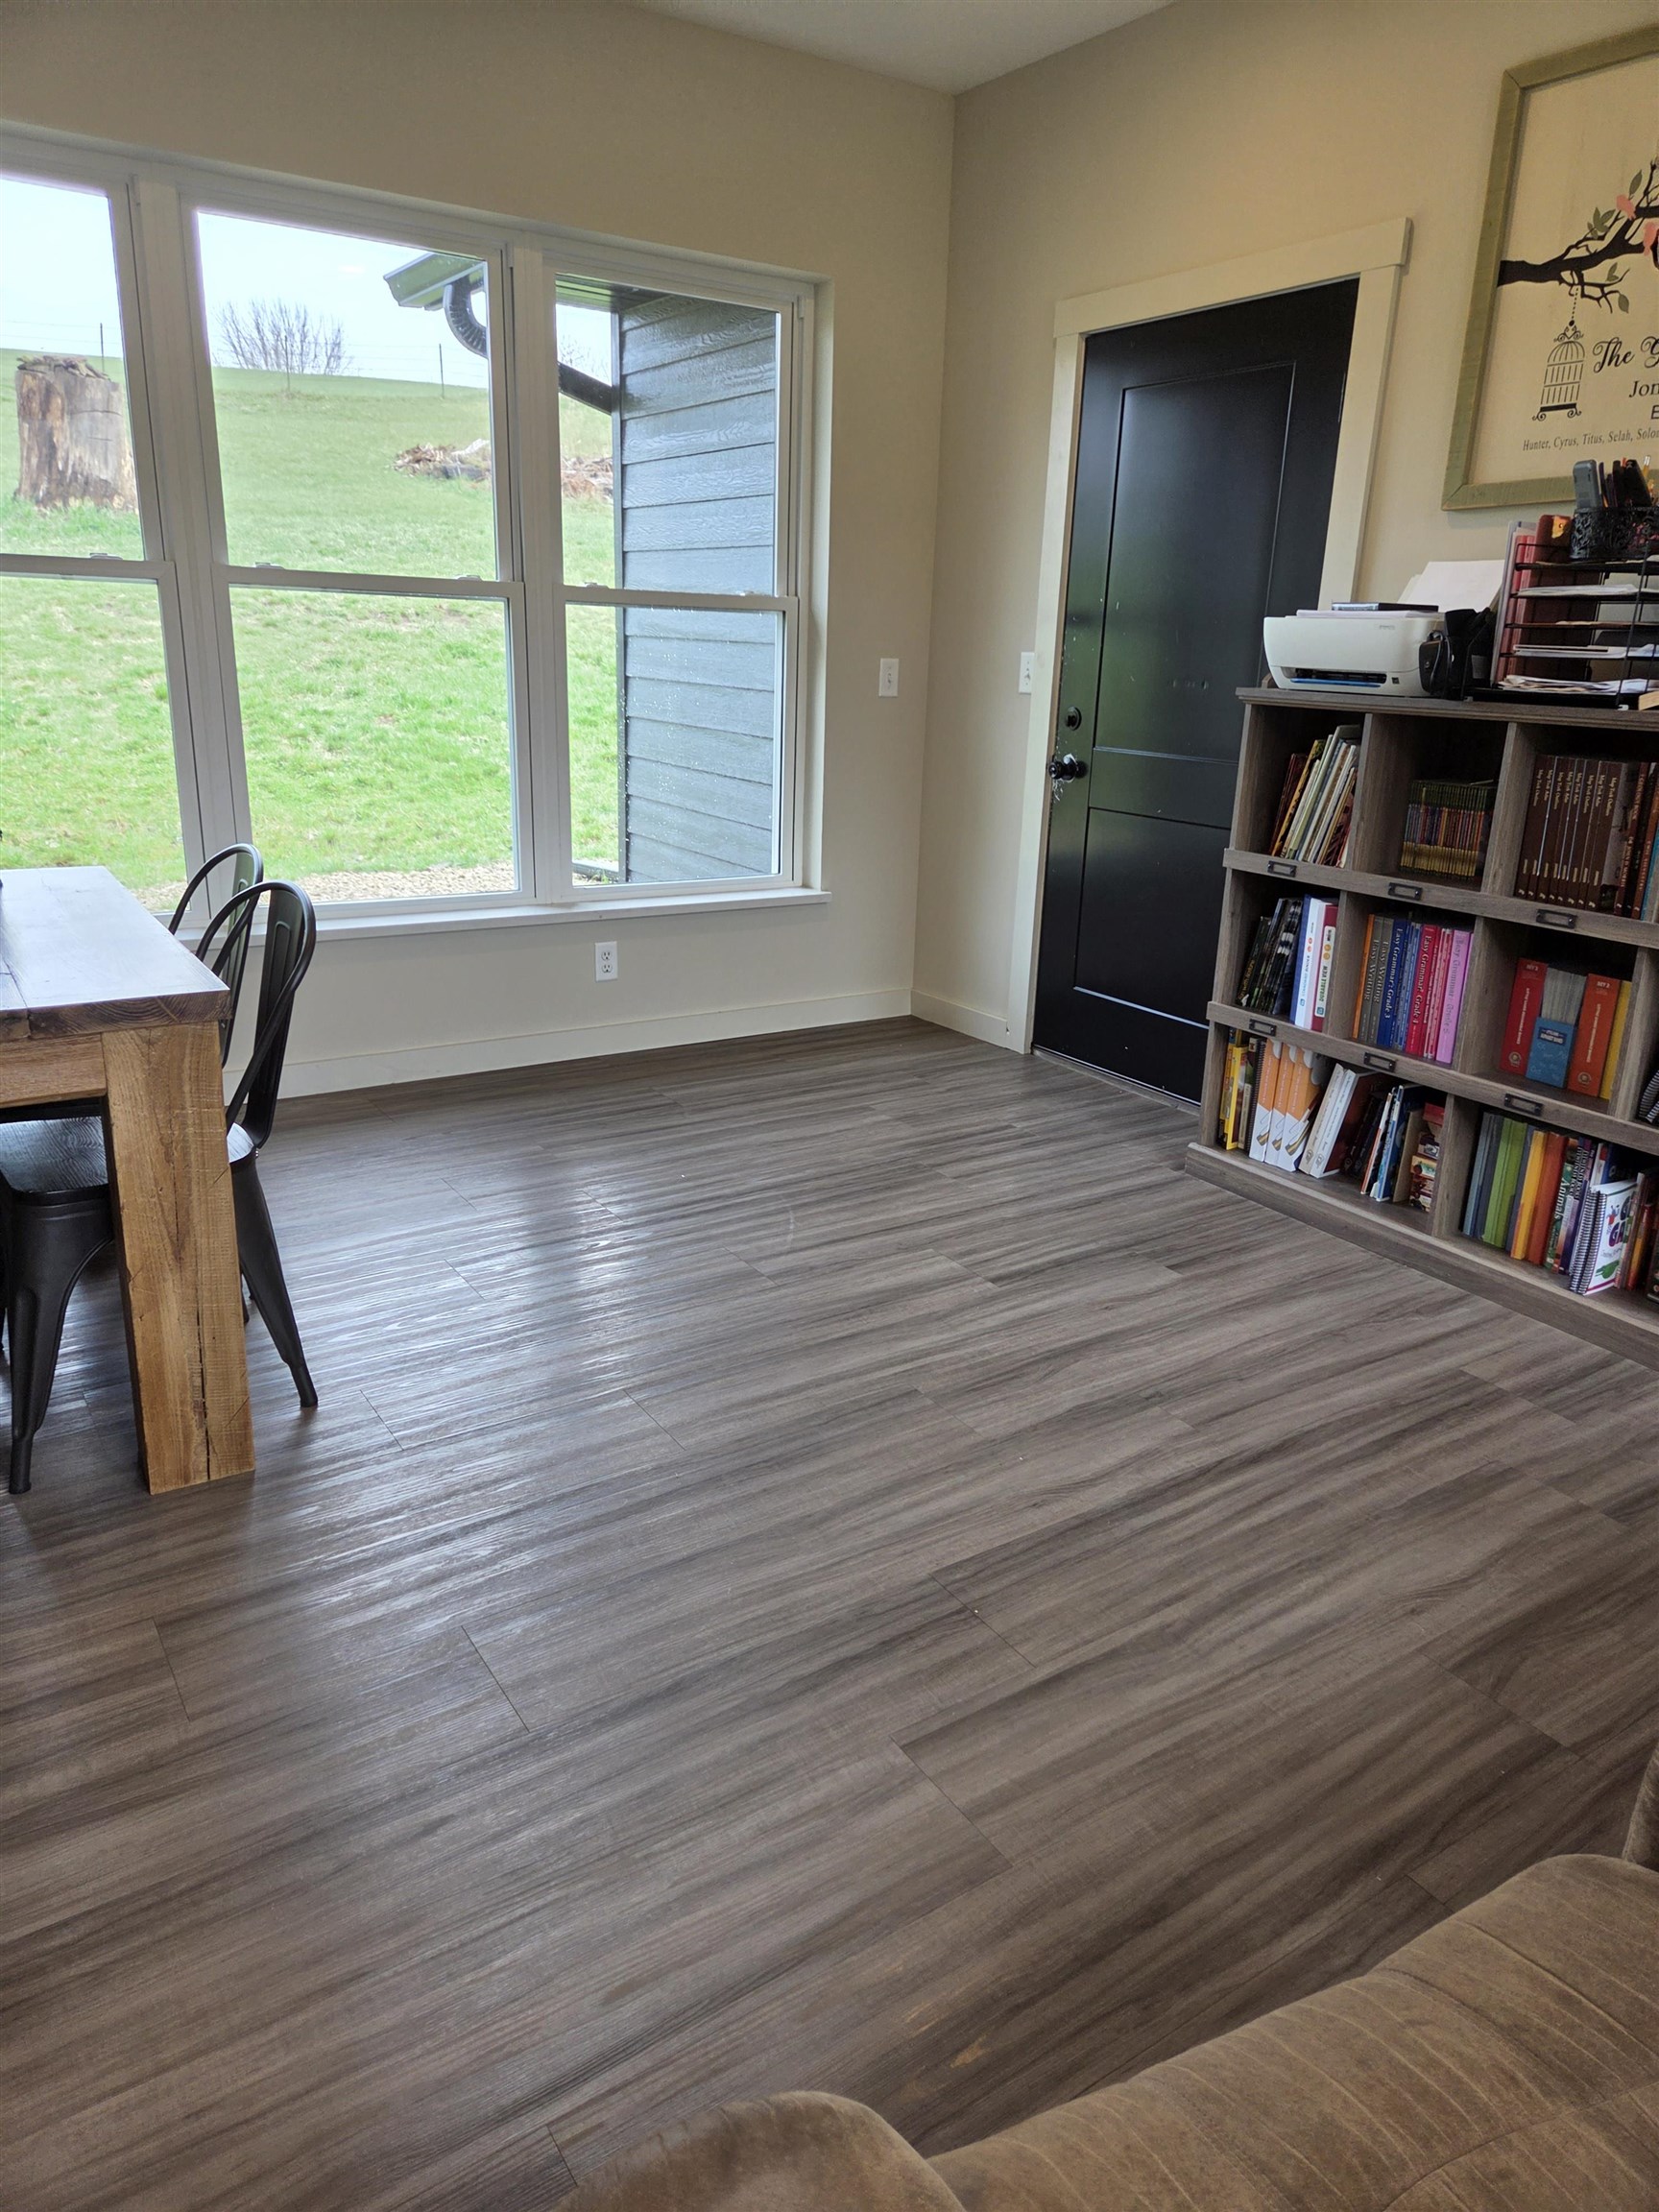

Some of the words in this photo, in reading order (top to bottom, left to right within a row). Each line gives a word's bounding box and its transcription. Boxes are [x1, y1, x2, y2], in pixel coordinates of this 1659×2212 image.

[1593, 337, 1635, 373] The
[1523, 440, 1551, 451] Hunter,
[1553, 437, 1579, 450] Cyrus,
[1583, 434, 1605, 445] Titus,
[1607, 430, 1633, 443] Selah,
[1370, 939, 1380, 960] Easy
[1380, 941, 1388, 962] Easy
[1422, 935, 1431, 952] Easy
[1364, 964, 1376, 1000] Writing
[1374, 966, 1385, 1003] Writing
[1413, 995, 1422, 1018] Grade
[1553, 1178, 1570, 1219] Animals
